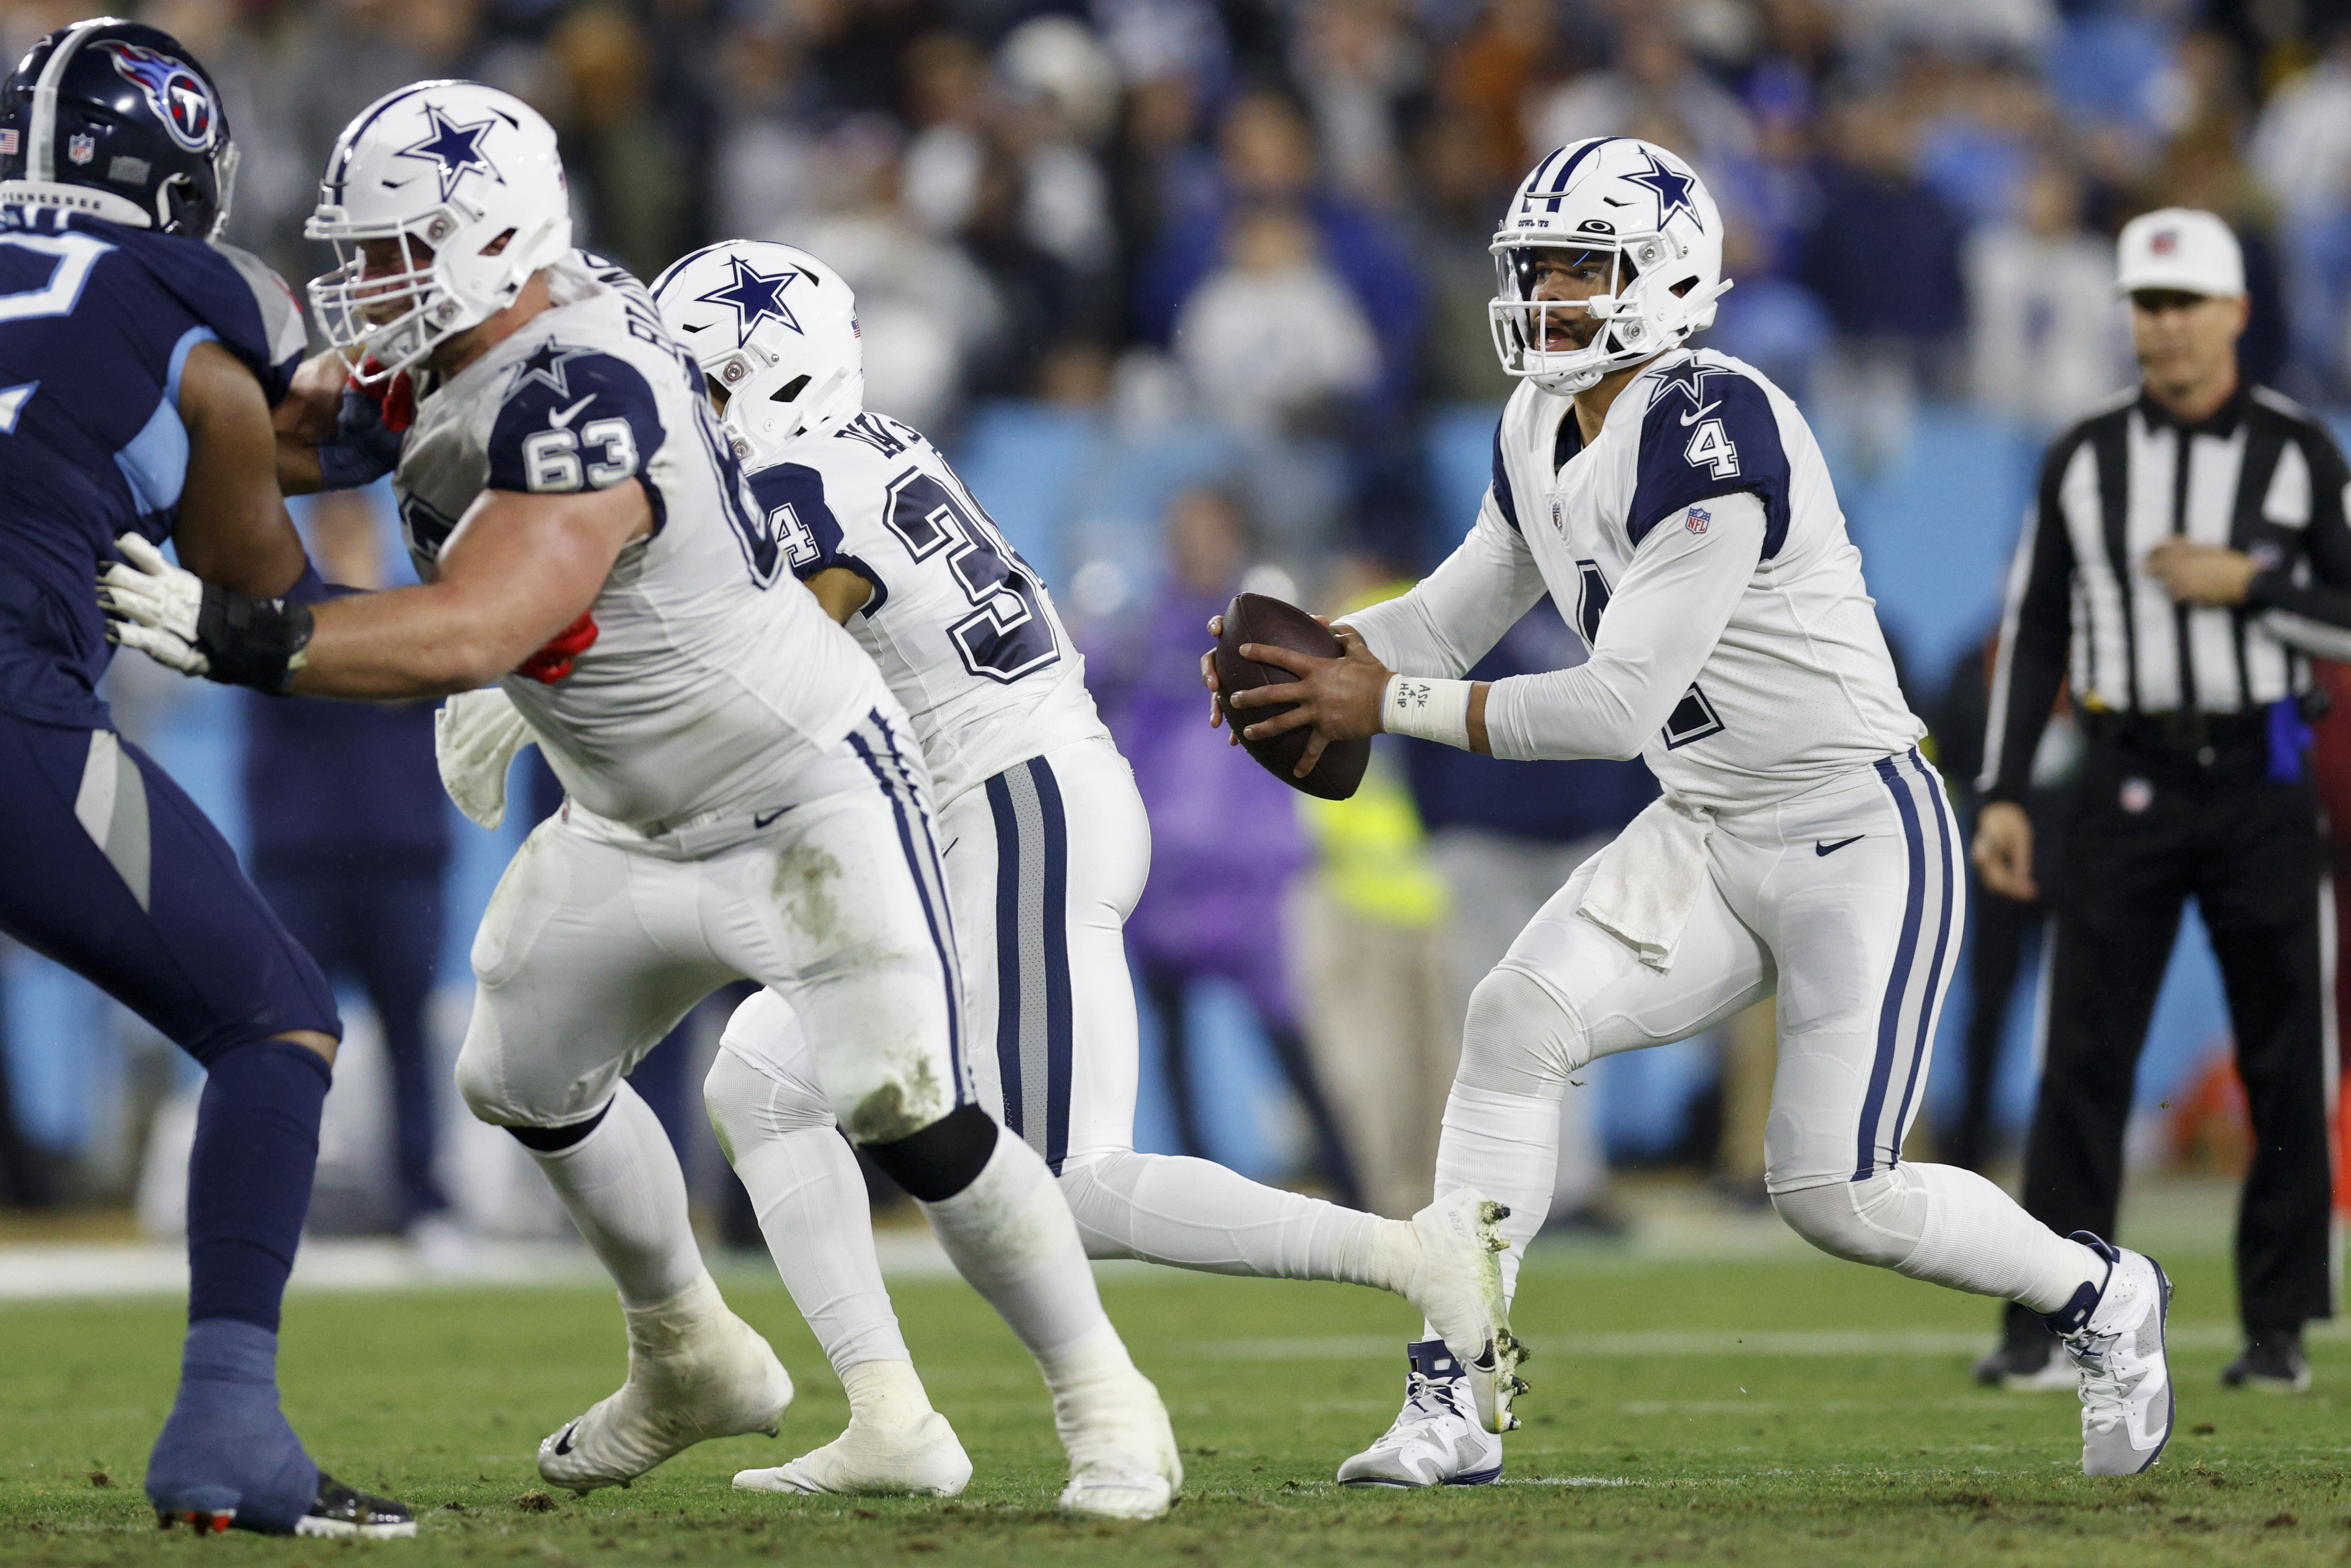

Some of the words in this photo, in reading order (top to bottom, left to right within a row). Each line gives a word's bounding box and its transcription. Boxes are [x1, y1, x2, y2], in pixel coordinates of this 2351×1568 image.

[521, 417, 639, 493] 63
[1683, 418, 1741, 481] 4
[768, 502, 821, 568] 4
[1687, 517, 1706, 532] NFL
